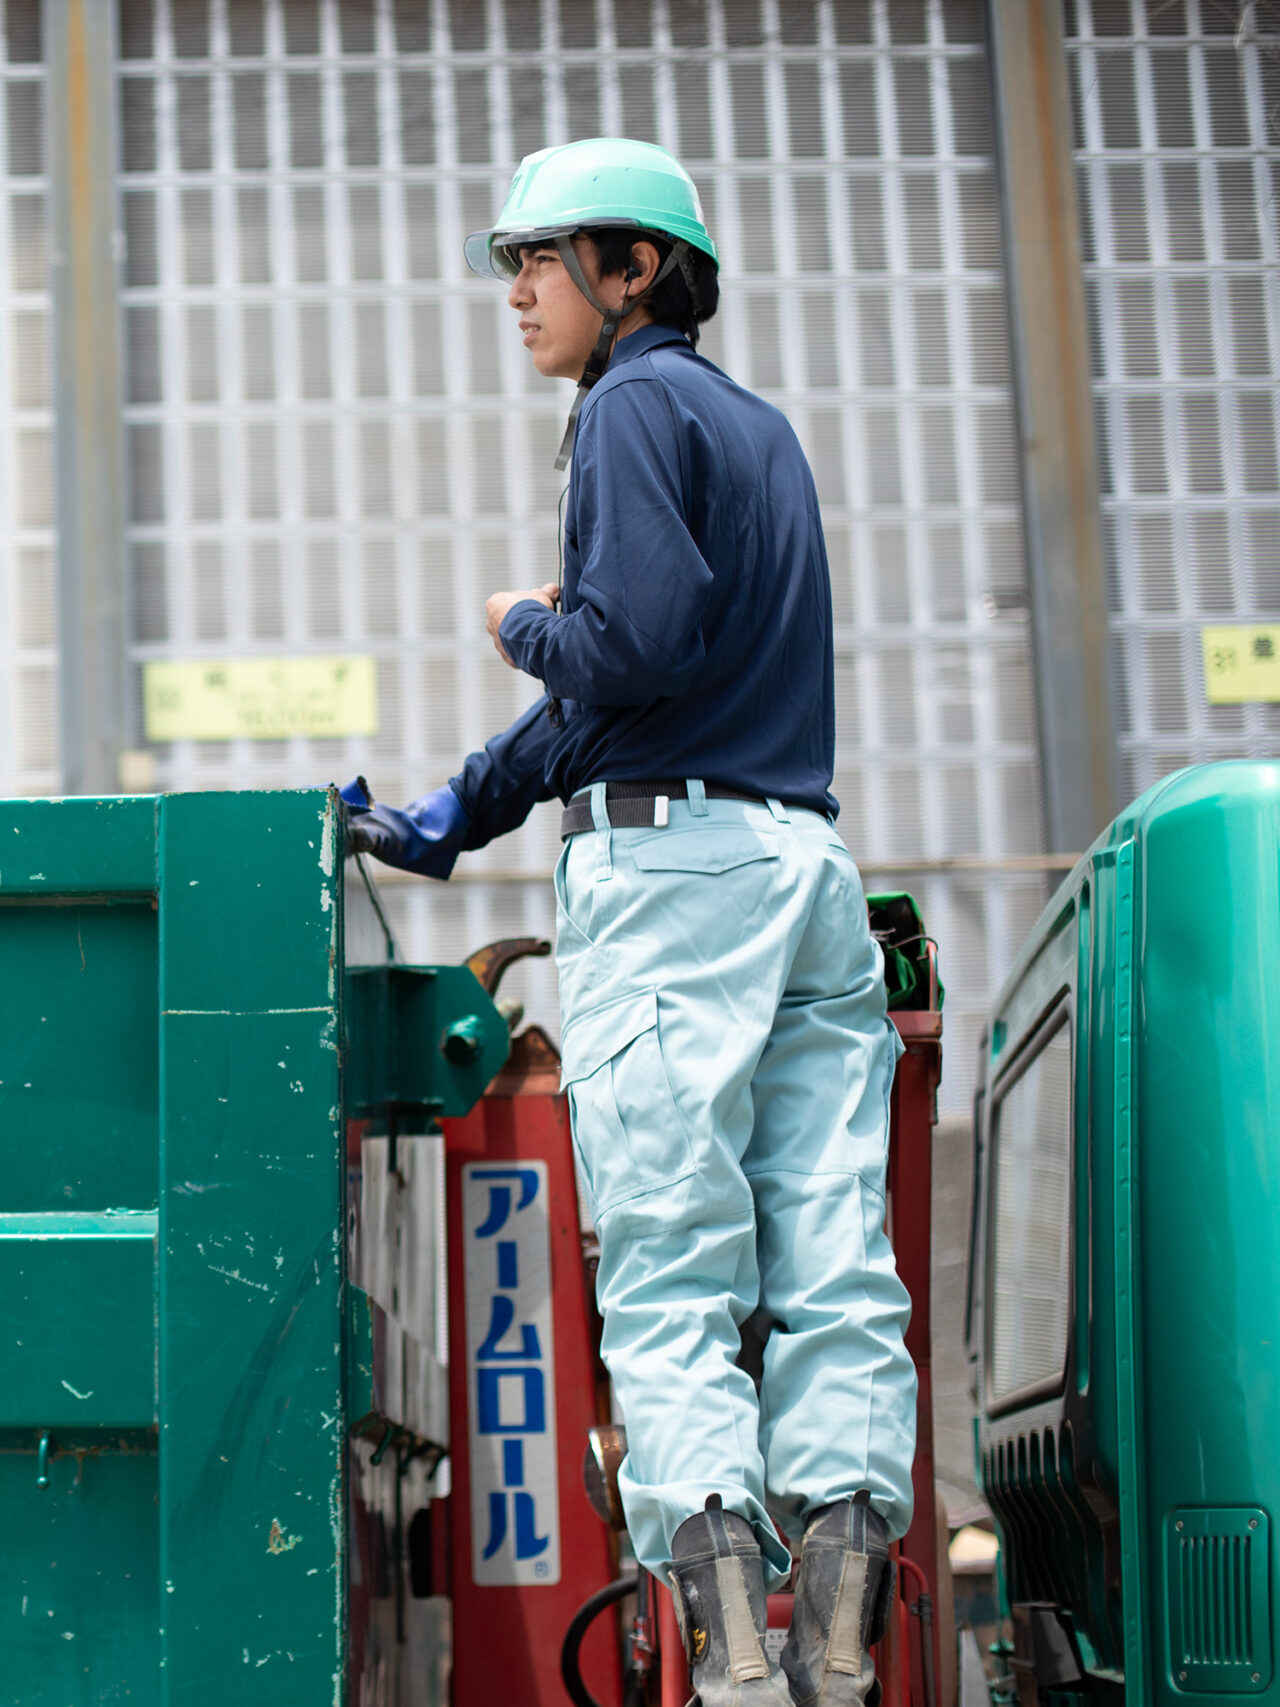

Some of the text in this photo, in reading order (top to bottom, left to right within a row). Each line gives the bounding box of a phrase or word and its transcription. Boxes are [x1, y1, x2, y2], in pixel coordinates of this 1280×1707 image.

[469, 1168, 550, 1562] アームロール
